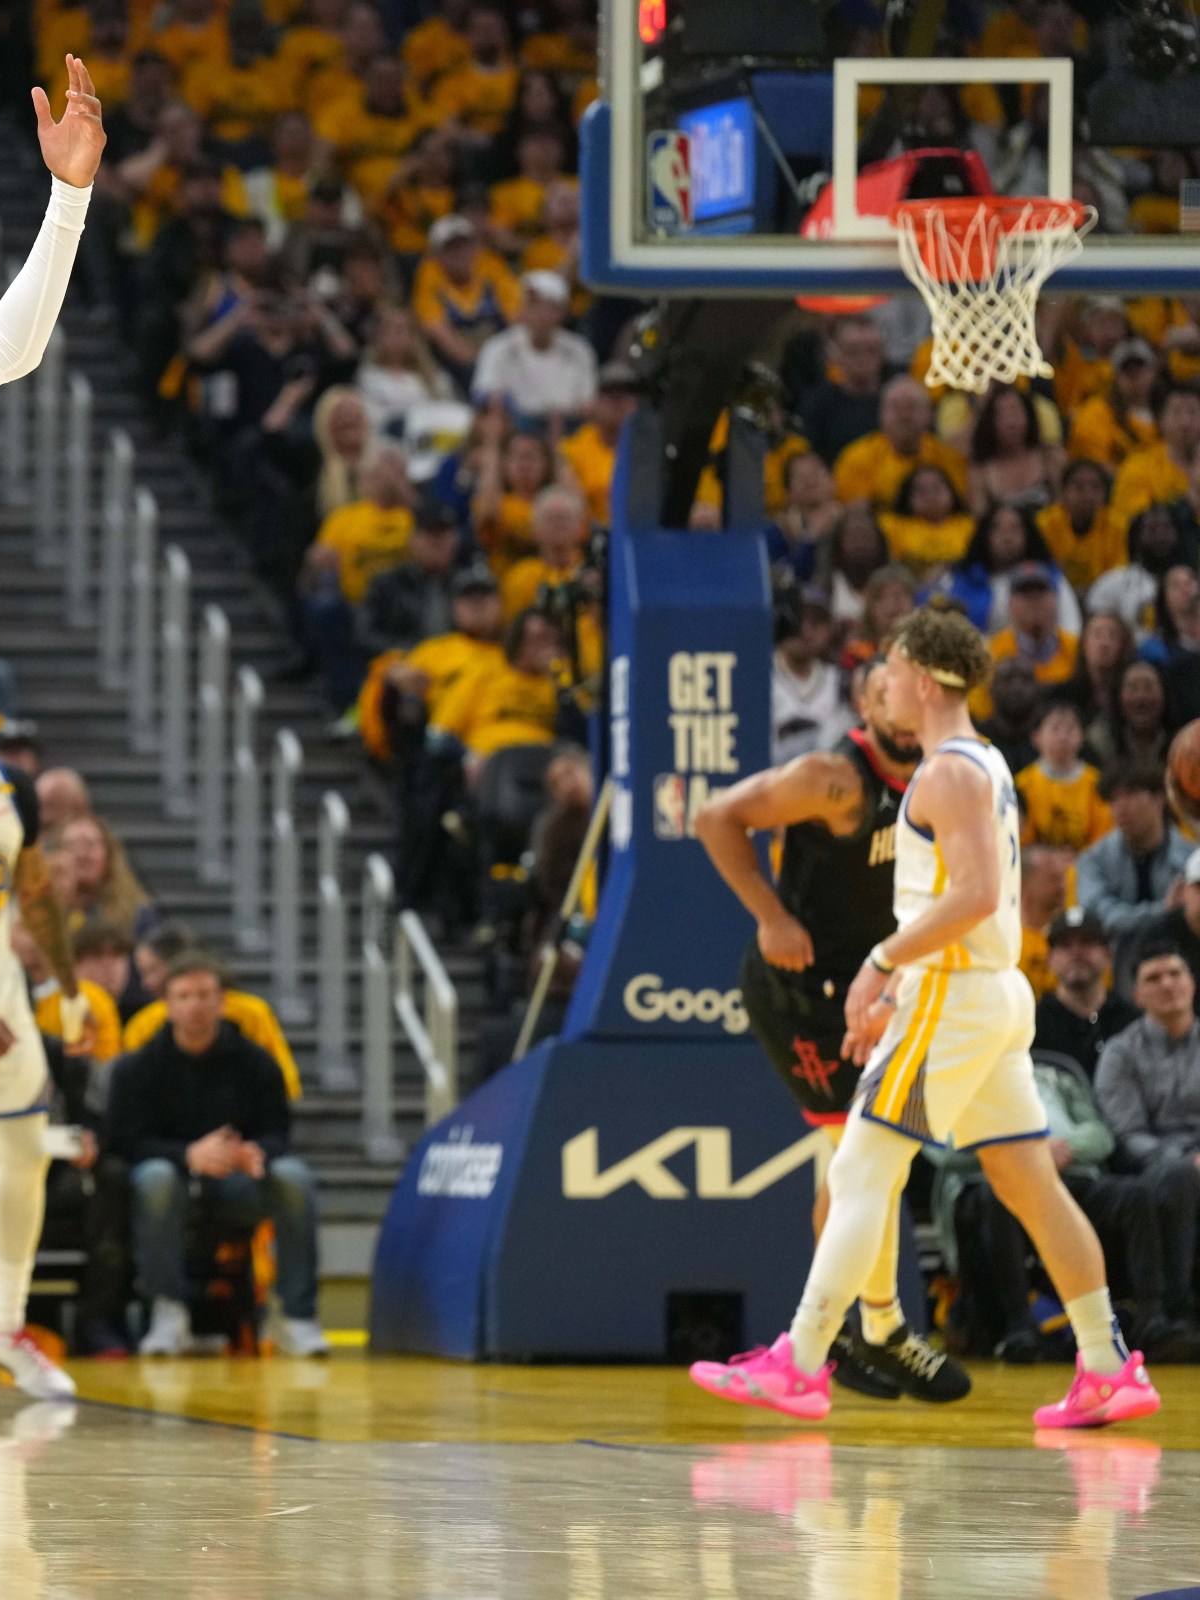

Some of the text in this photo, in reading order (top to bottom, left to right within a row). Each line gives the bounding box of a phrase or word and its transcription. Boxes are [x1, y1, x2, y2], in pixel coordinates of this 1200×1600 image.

[668, 651, 738, 711] GET
[668, 713, 739, 774] THE
[623, 973, 750, 1035] Goog
